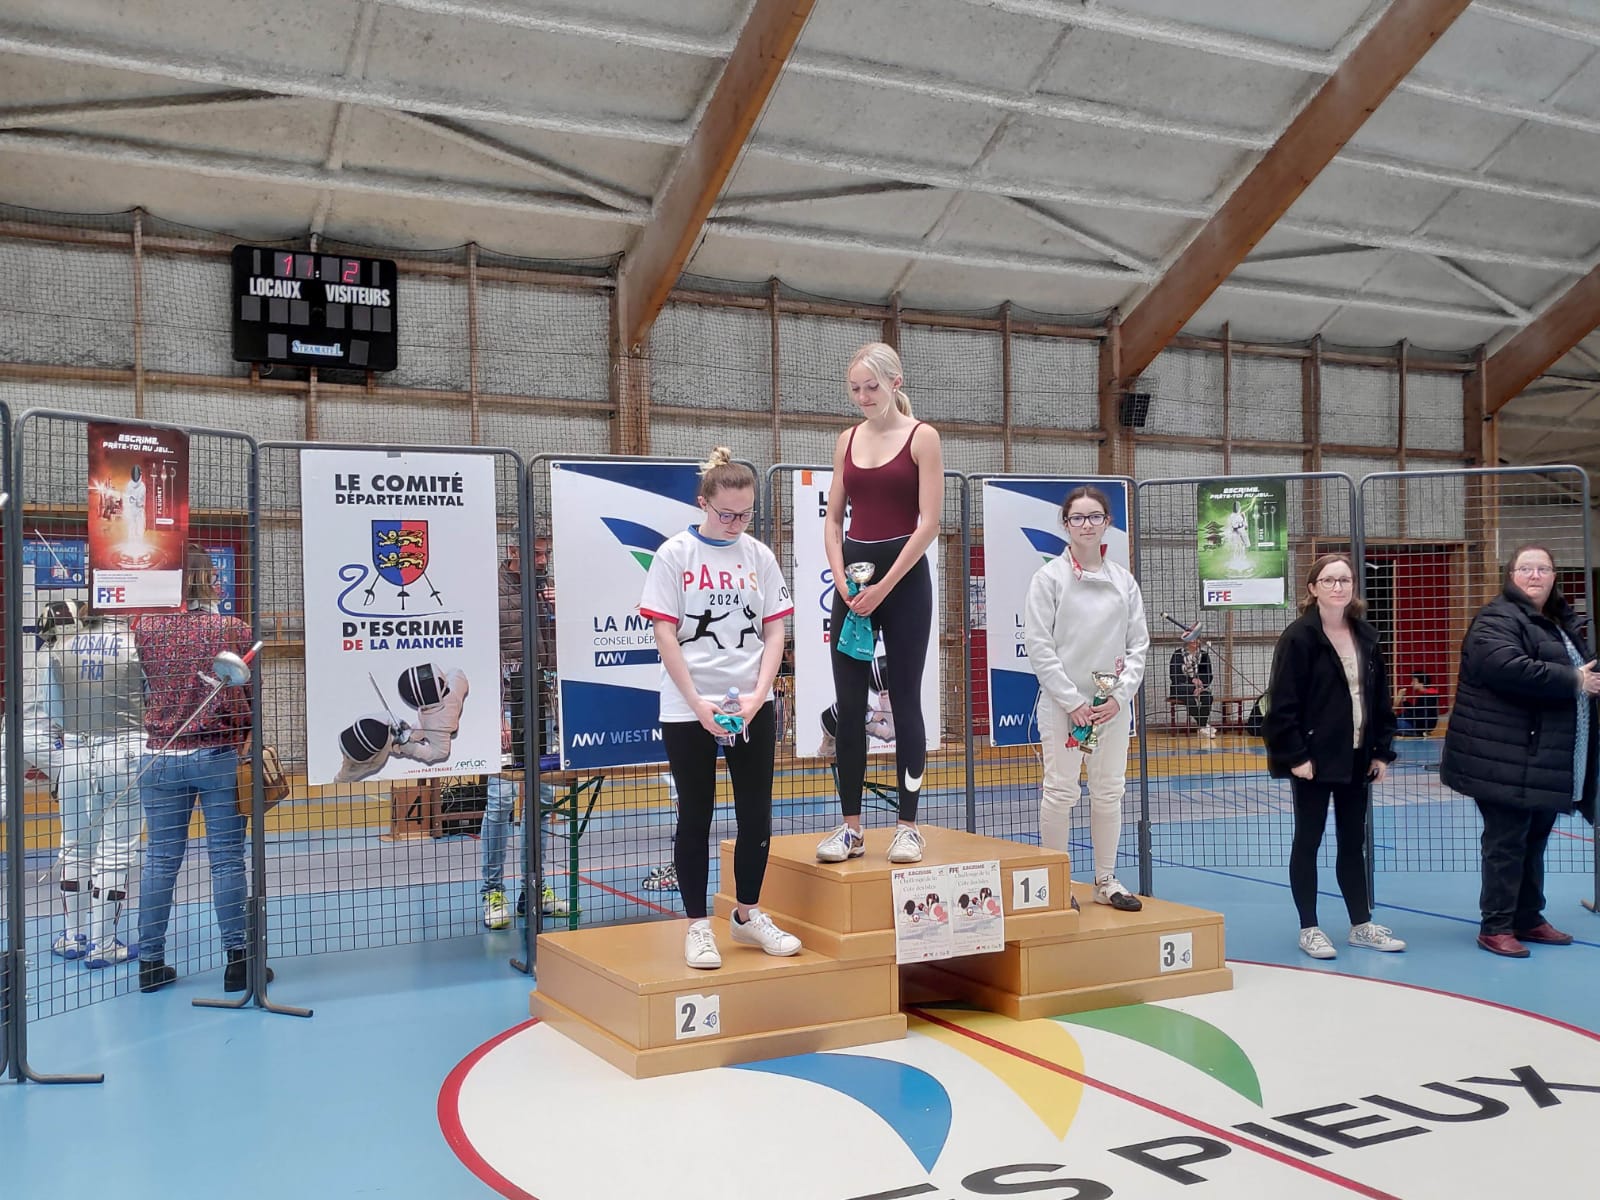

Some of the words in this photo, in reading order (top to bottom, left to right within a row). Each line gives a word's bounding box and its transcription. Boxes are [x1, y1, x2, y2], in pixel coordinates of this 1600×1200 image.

[249, 277, 302, 299] LOCAUX
[325, 284, 391, 307] VISITEURS
[335, 473, 360, 491] LE
[371, 472, 463, 493] COMITÉ
[335, 491, 464, 506] DÉPARTEMENTAL
[97, 587, 126, 603] FFE
[709, 594, 739, 606] 2024
[1207, 591, 1232, 602] FFE
[342, 620, 463, 638] D'ESCRIME
[594, 615, 618, 632] LA
[343, 639, 363, 651] DE
[370, 638, 390, 650] LA
[396, 637, 463, 650] MANCHE
[593, 636, 635, 646] CONSEIL
[80, 659, 104, 680] FRA
[405, 796, 423, 825] 4
[1020, 877, 1030, 903] 1
[1163, 941, 1176, 967] 3
[681, 1002, 697, 1033] 2
[1106, 1065, 1600, 1186] PIEUX
